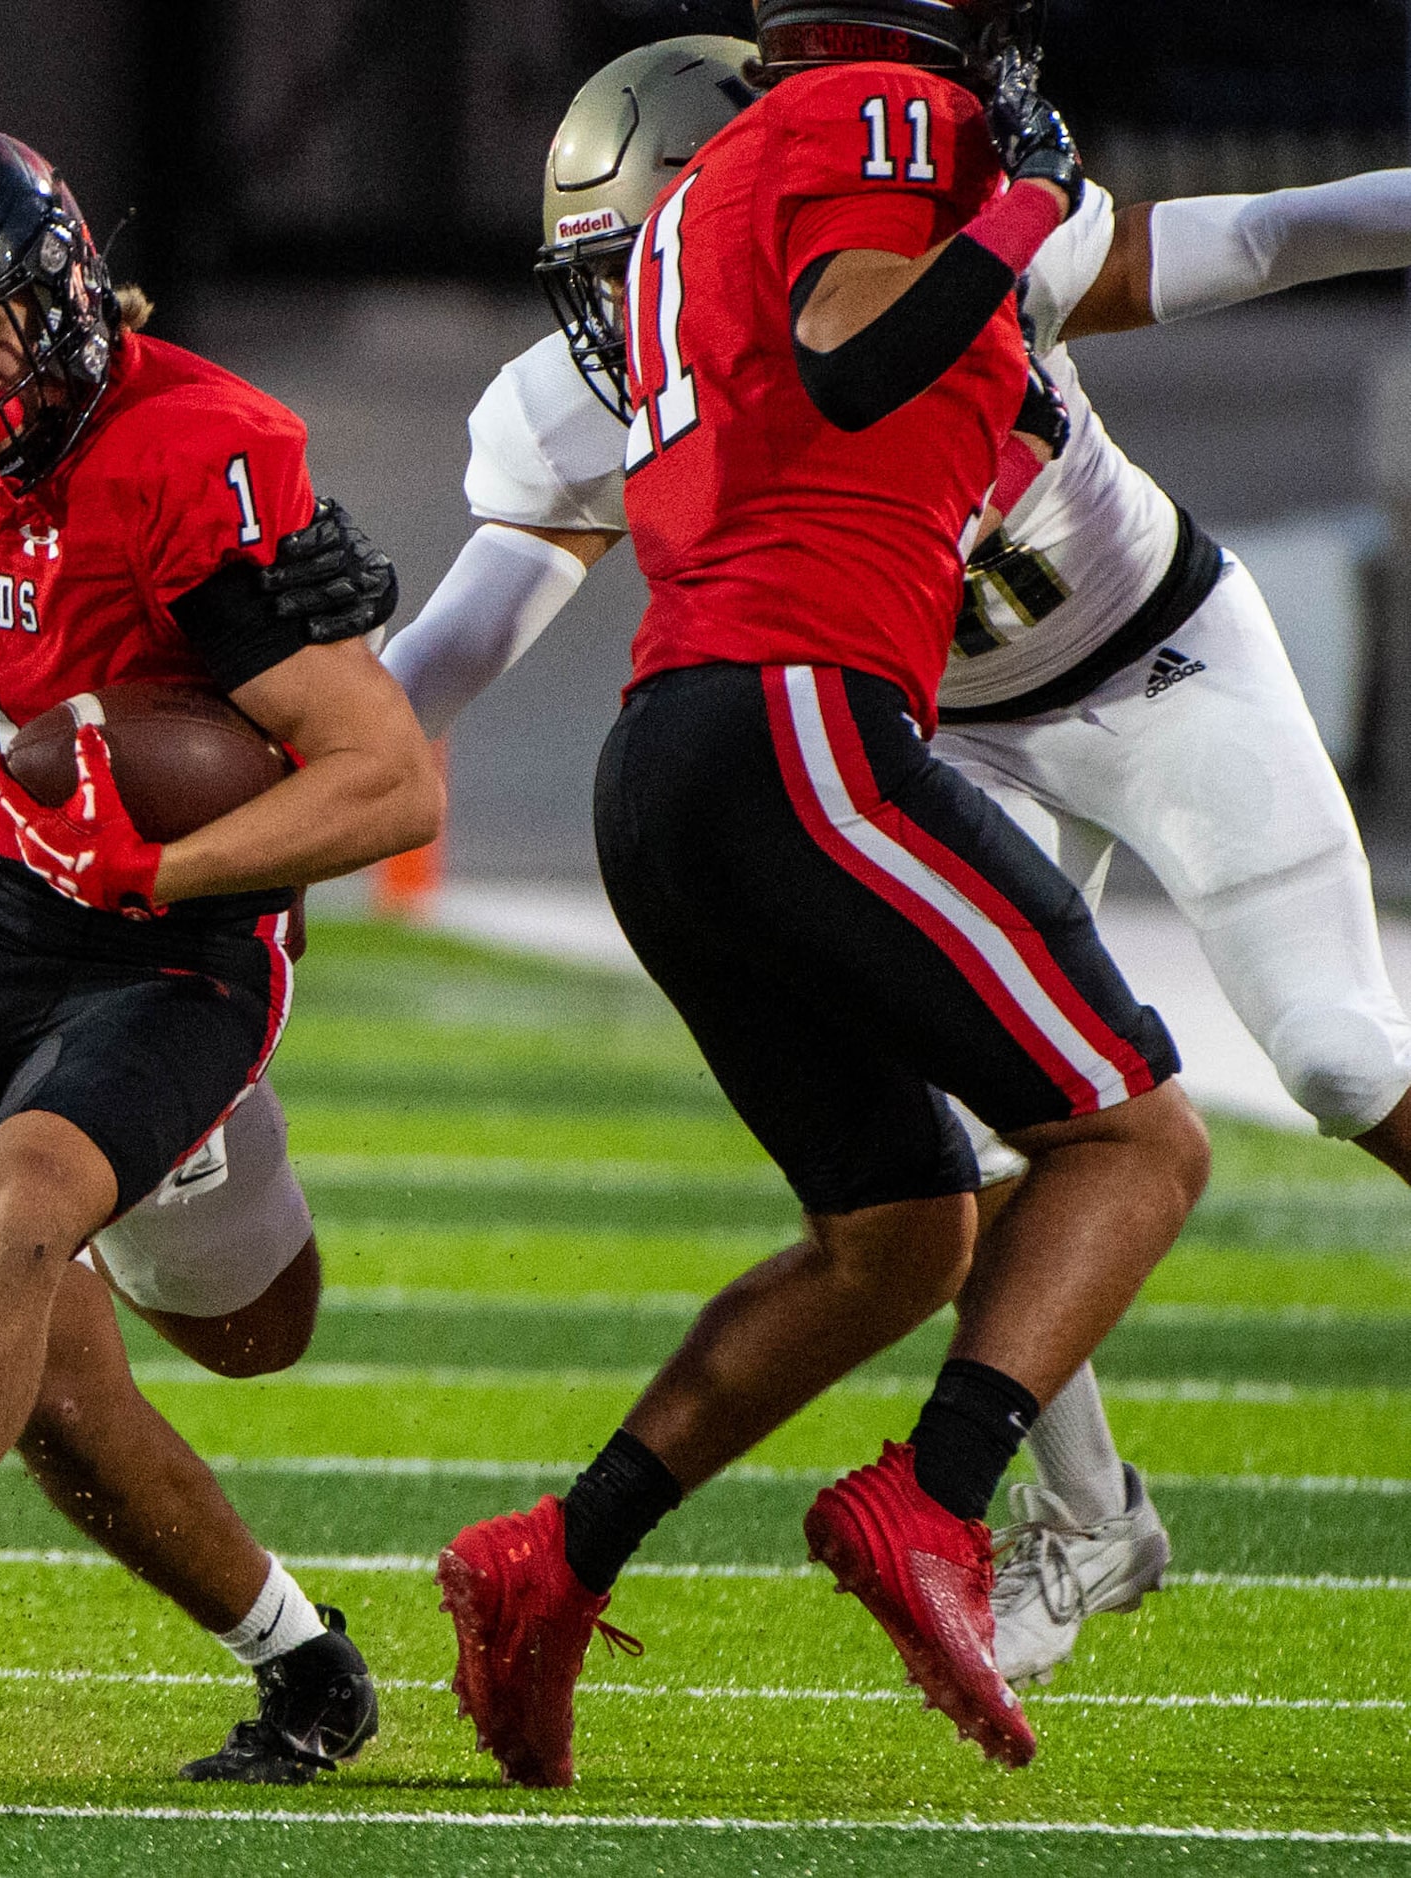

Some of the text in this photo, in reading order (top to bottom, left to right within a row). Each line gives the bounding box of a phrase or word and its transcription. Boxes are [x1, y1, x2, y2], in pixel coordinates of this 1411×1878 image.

[861, 95, 937, 183] 11
[559, 212, 614, 238] Riddell
[225, 452, 261, 546] 1
[1145, 660, 1207, 698] adidas
